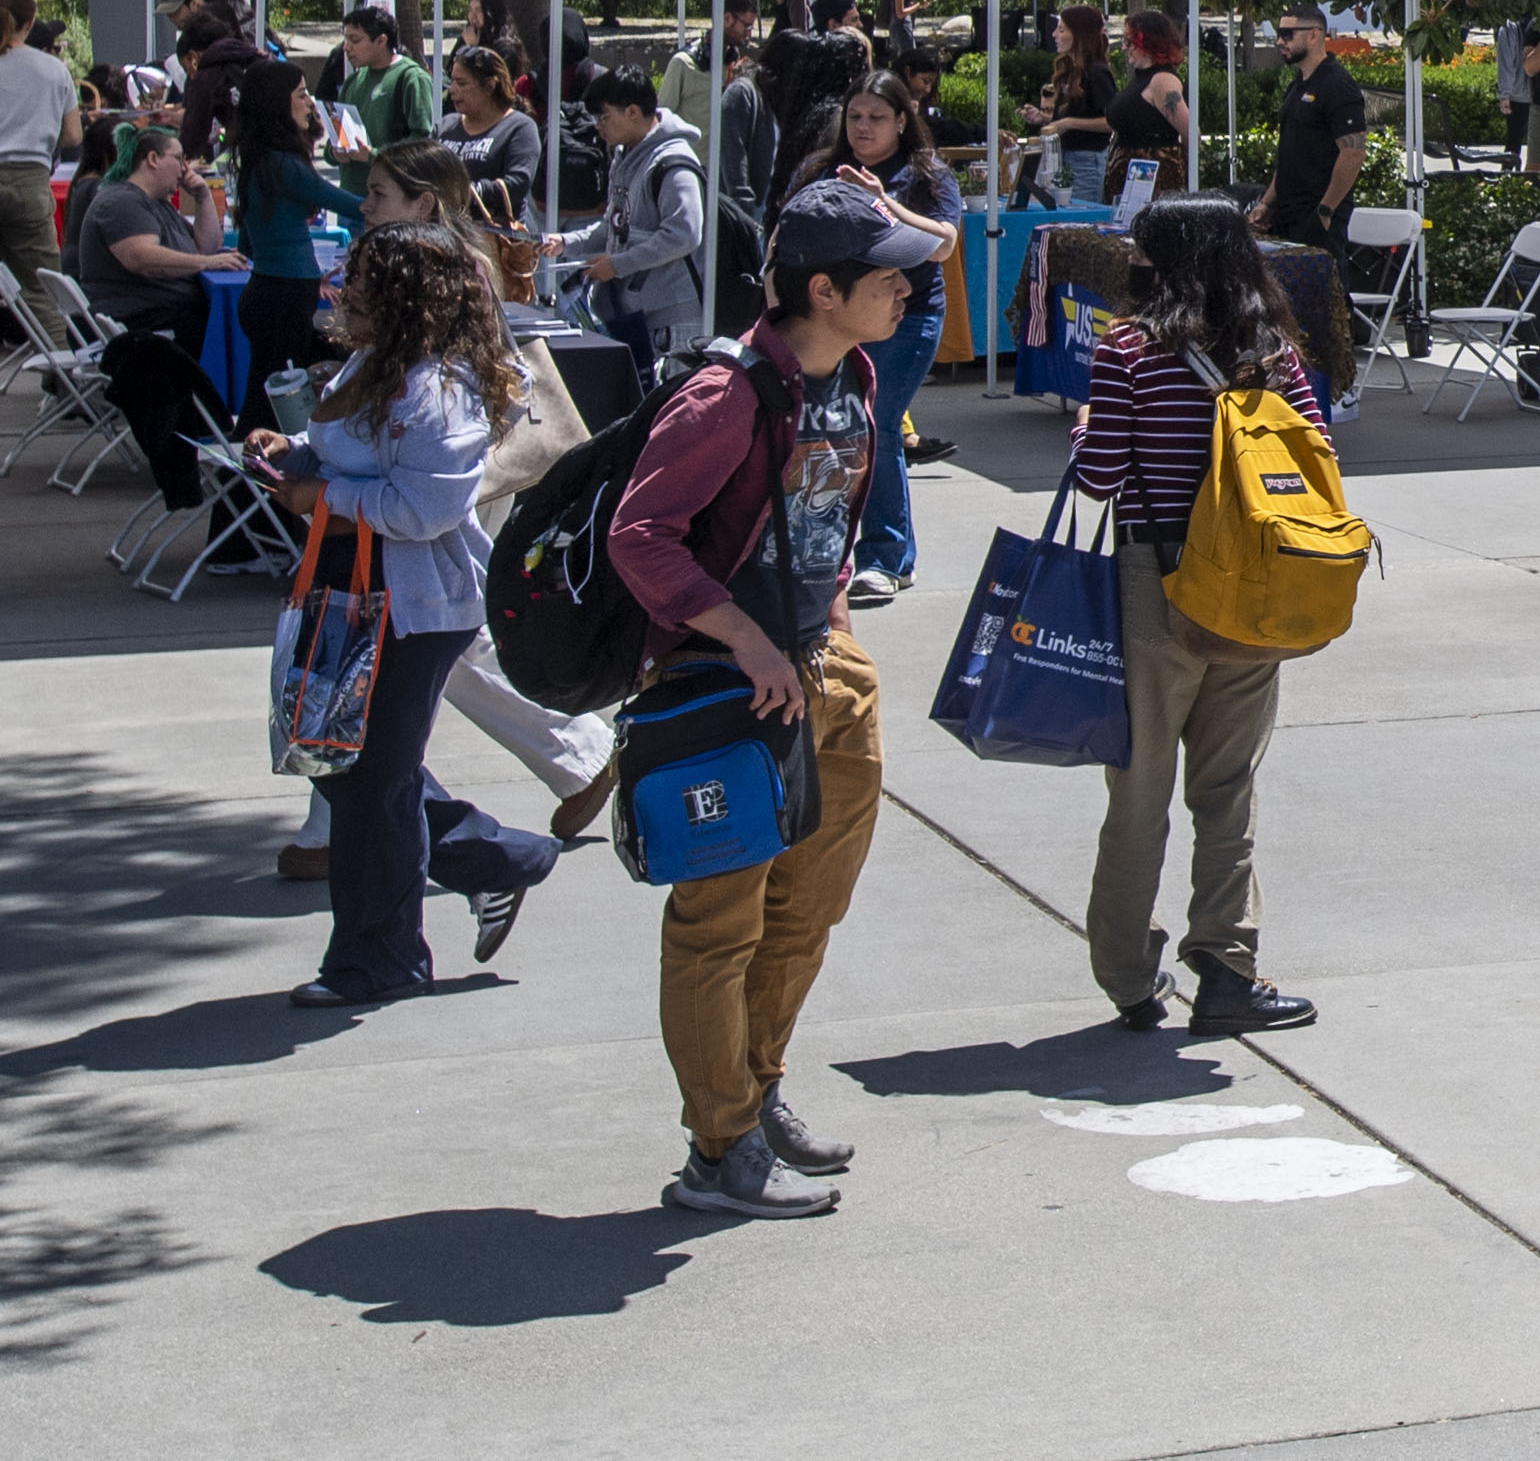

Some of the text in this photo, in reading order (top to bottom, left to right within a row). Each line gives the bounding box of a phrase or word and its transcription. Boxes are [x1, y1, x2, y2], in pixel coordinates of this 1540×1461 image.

[1036, 628, 1087, 659] Links
[1089, 639, 1114, 653] 24/7
[1013, 652, 1125, 686] First Responders for Mental Hea
[1087, 650, 1121, 668] 855-OC
